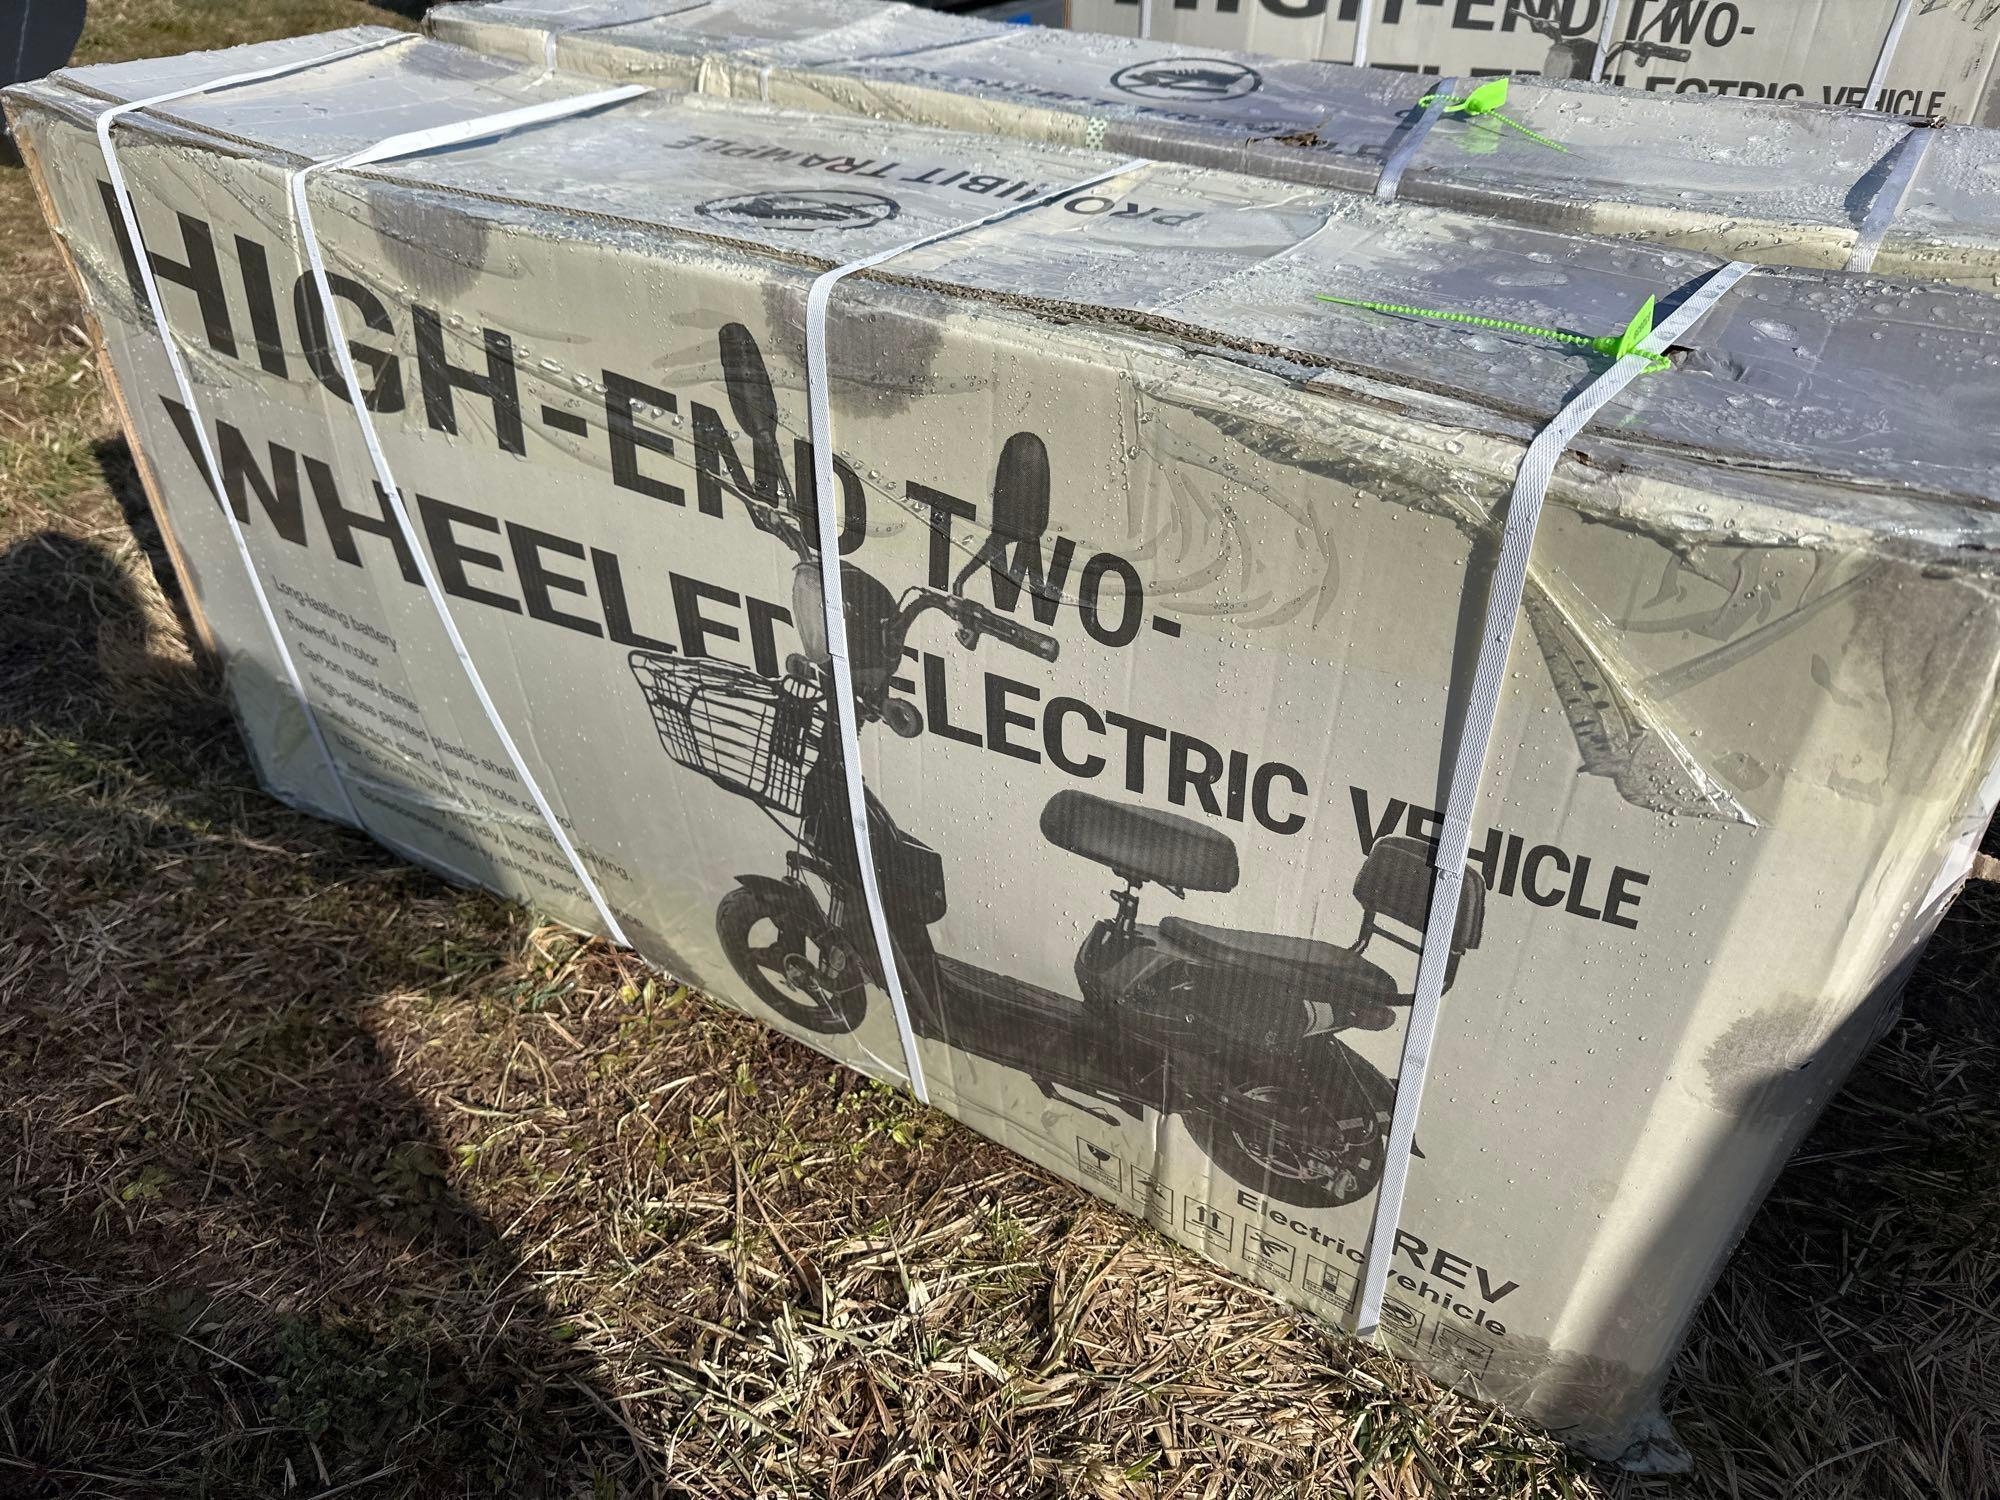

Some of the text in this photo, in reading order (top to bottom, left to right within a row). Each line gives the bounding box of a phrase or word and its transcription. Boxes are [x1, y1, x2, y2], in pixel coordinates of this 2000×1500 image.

[1625, 0, 1756, 48] TWO-
[663, 135, 901, 179] TRAMPLE
[97, 178, 1182, 648] HIGH-END TWO-
[272, 574, 397, 653] Long-lasting battery
[285, 608, 379, 667] Powerful motor
[378, 682, 420, 713] frame
[431, 735, 480, 765] plastic
[481, 758, 518, 783] shell
[466, 775, 519, 807] remote
[521, 800, 576, 831] corol
[506, 834, 540, 862] long
[541, 850, 601, 886] lifespn
[1237, 1189, 1366, 1264] Electric
